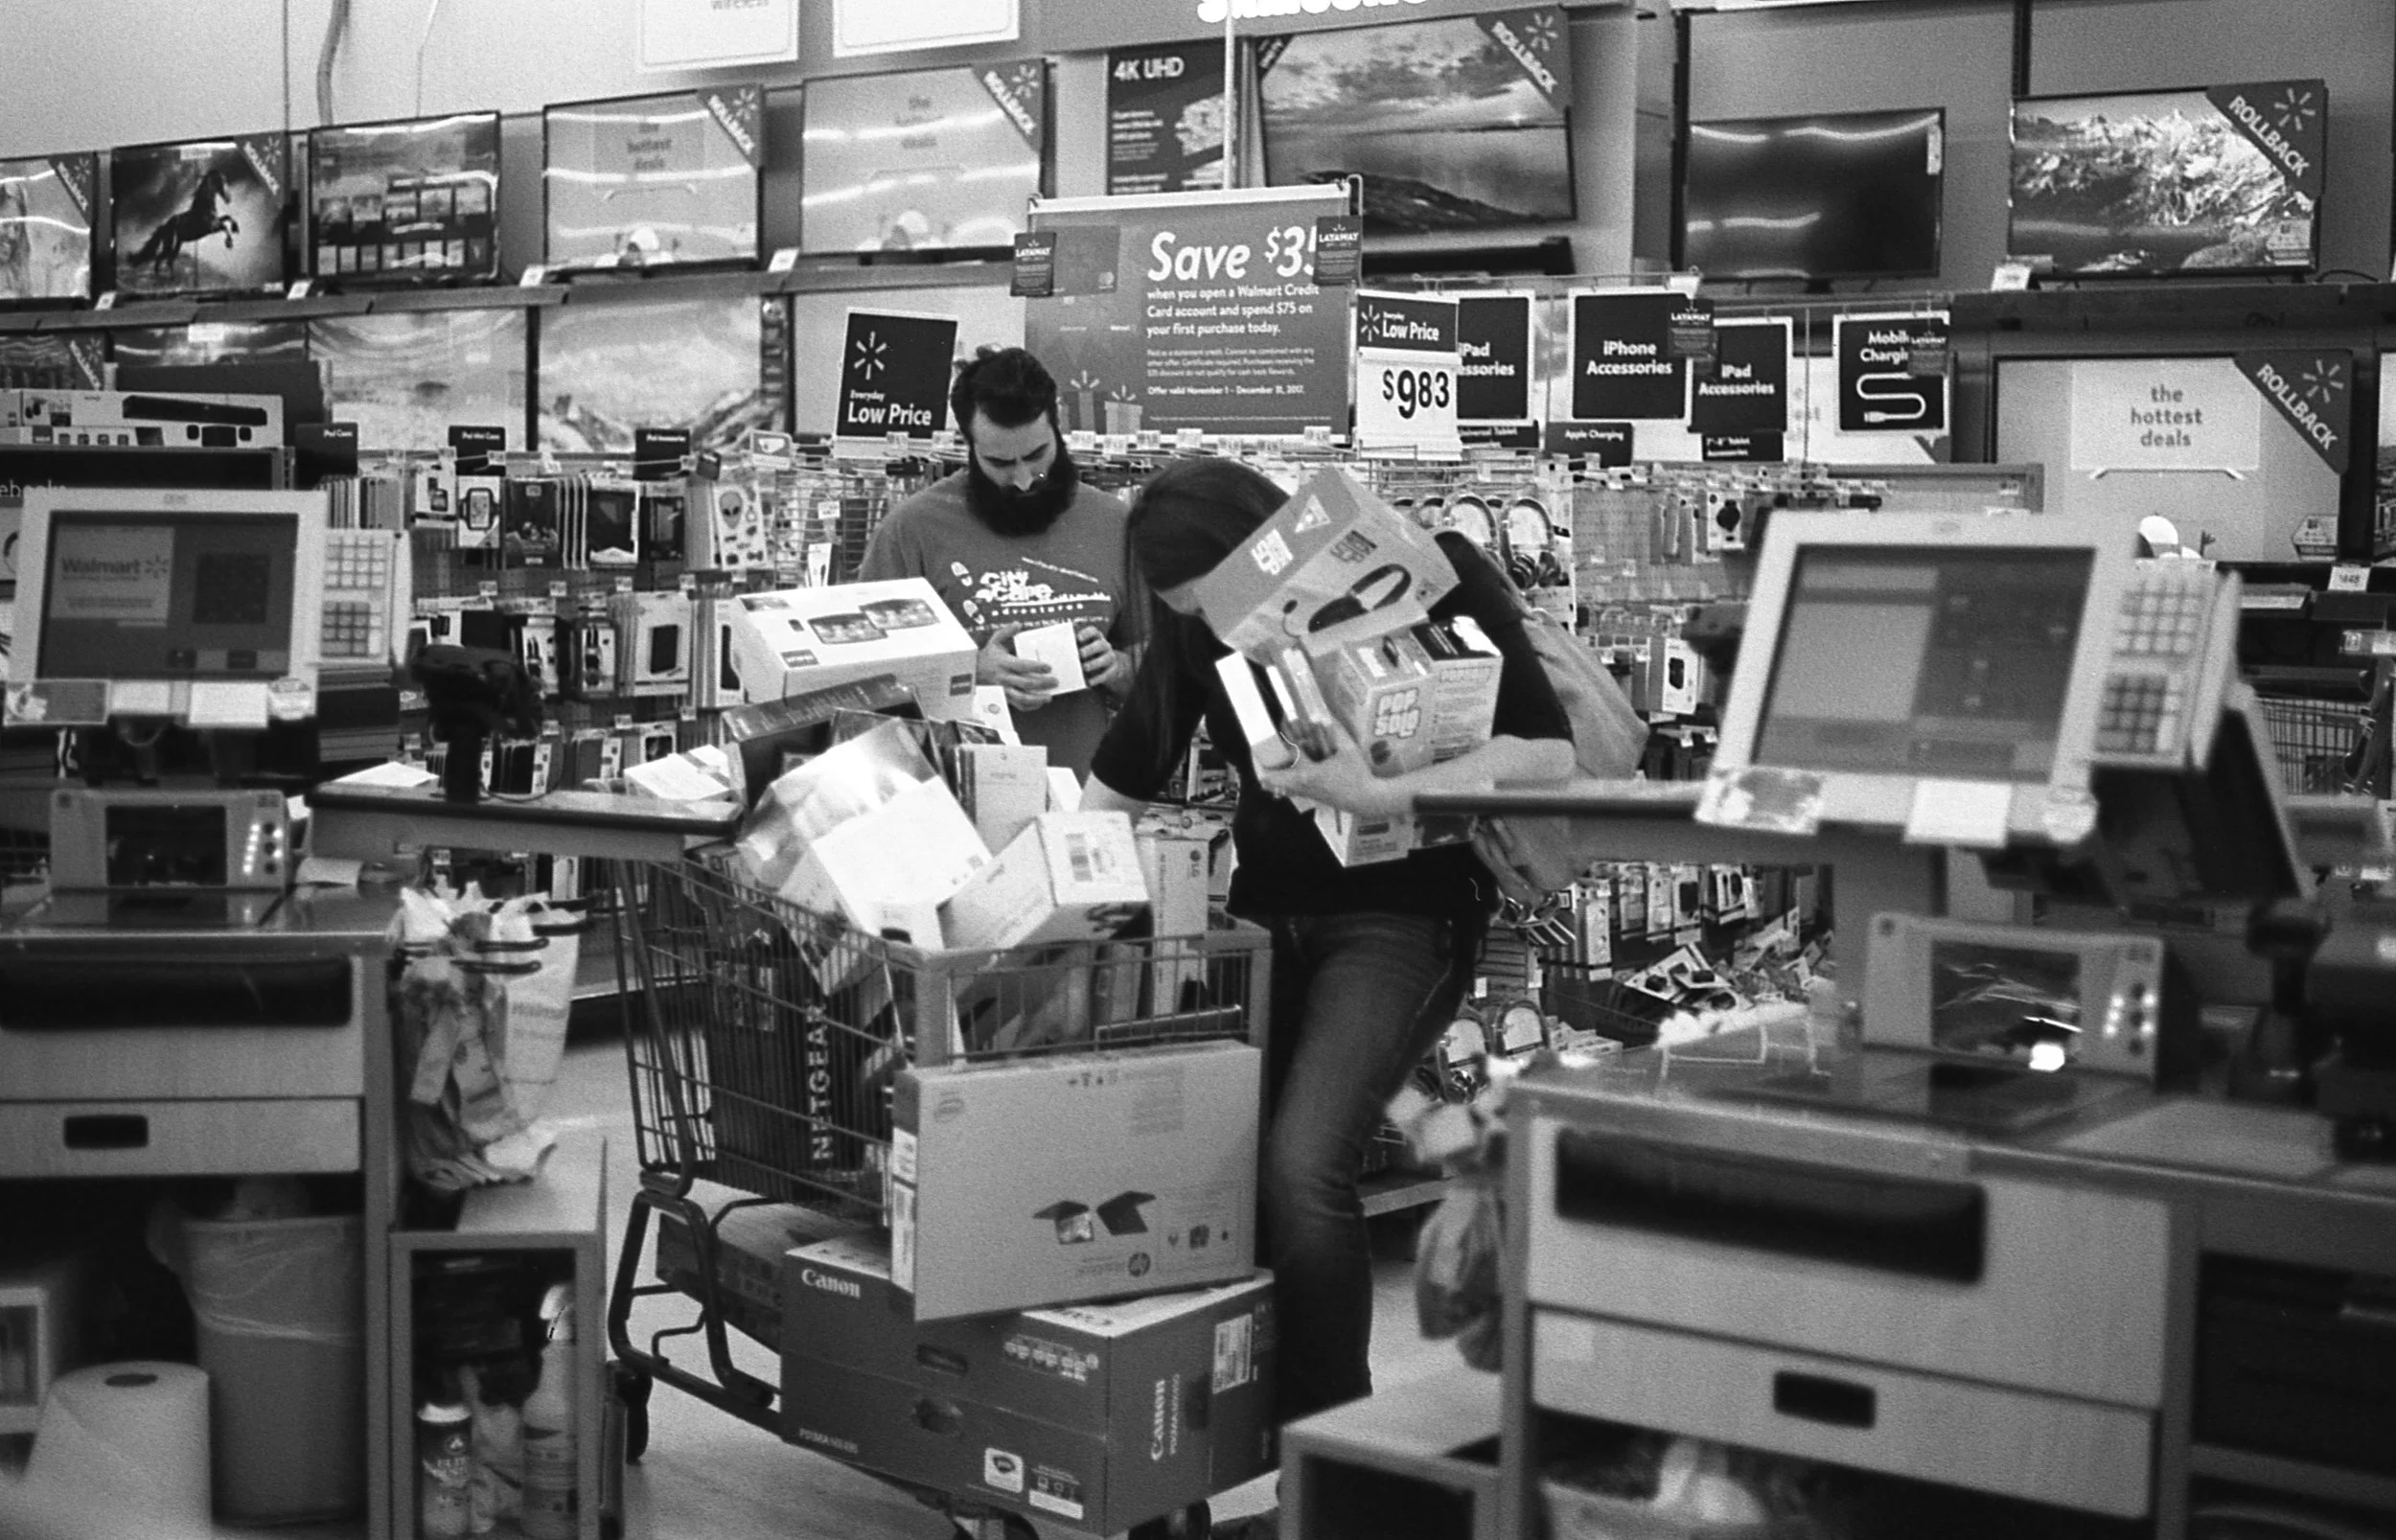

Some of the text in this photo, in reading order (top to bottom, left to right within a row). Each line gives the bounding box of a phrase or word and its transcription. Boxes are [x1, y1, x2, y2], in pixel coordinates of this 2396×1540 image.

[1491, 20, 1558, 94] ROLLBACK
[1114, 57, 1185, 81] 4K UHD
[2227, 95, 2311, 177] ROLLBACK
[1147, 231, 1252, 282] Save
[1146, 283, 1320, 302] when you open a Walmart Credit
[1146, 301, 1313, 319] Card account and spend $75 on
[1146, 325, 1170, 338] your
[1173, 323, 1195, 335] first
[1197, 323, 1246, 337] purchase
[1248, 320, 1281, 335] today.
[1383, 320, 1440, 341] Low Price
[1602, 339, 1657, 356] iPhone
[1859, 347, 1909, 366] Chargi
[1586, 358, 1673, 376] Accessories
[1720, 363, 1753, 379] iPad
[849, 389, 887, 402] Everyday
[1698, 380, 1775, 397] Accessories
[2150, 383, 2183, 403] the
[847, 402, 933, 426] Low Price
[2130, 406, 2203, 425] hottest
[2255, 363, 2338, 450] ROLLBACK
[2139, 427, 2192, 448] deals
[60, 557, 141, 575] Walmart
[805, 1005, 834, 1160] NETGEAR
[800, 1268, 861, 1299] Canon
[1151, 1378, 1166, 1461] Canon
